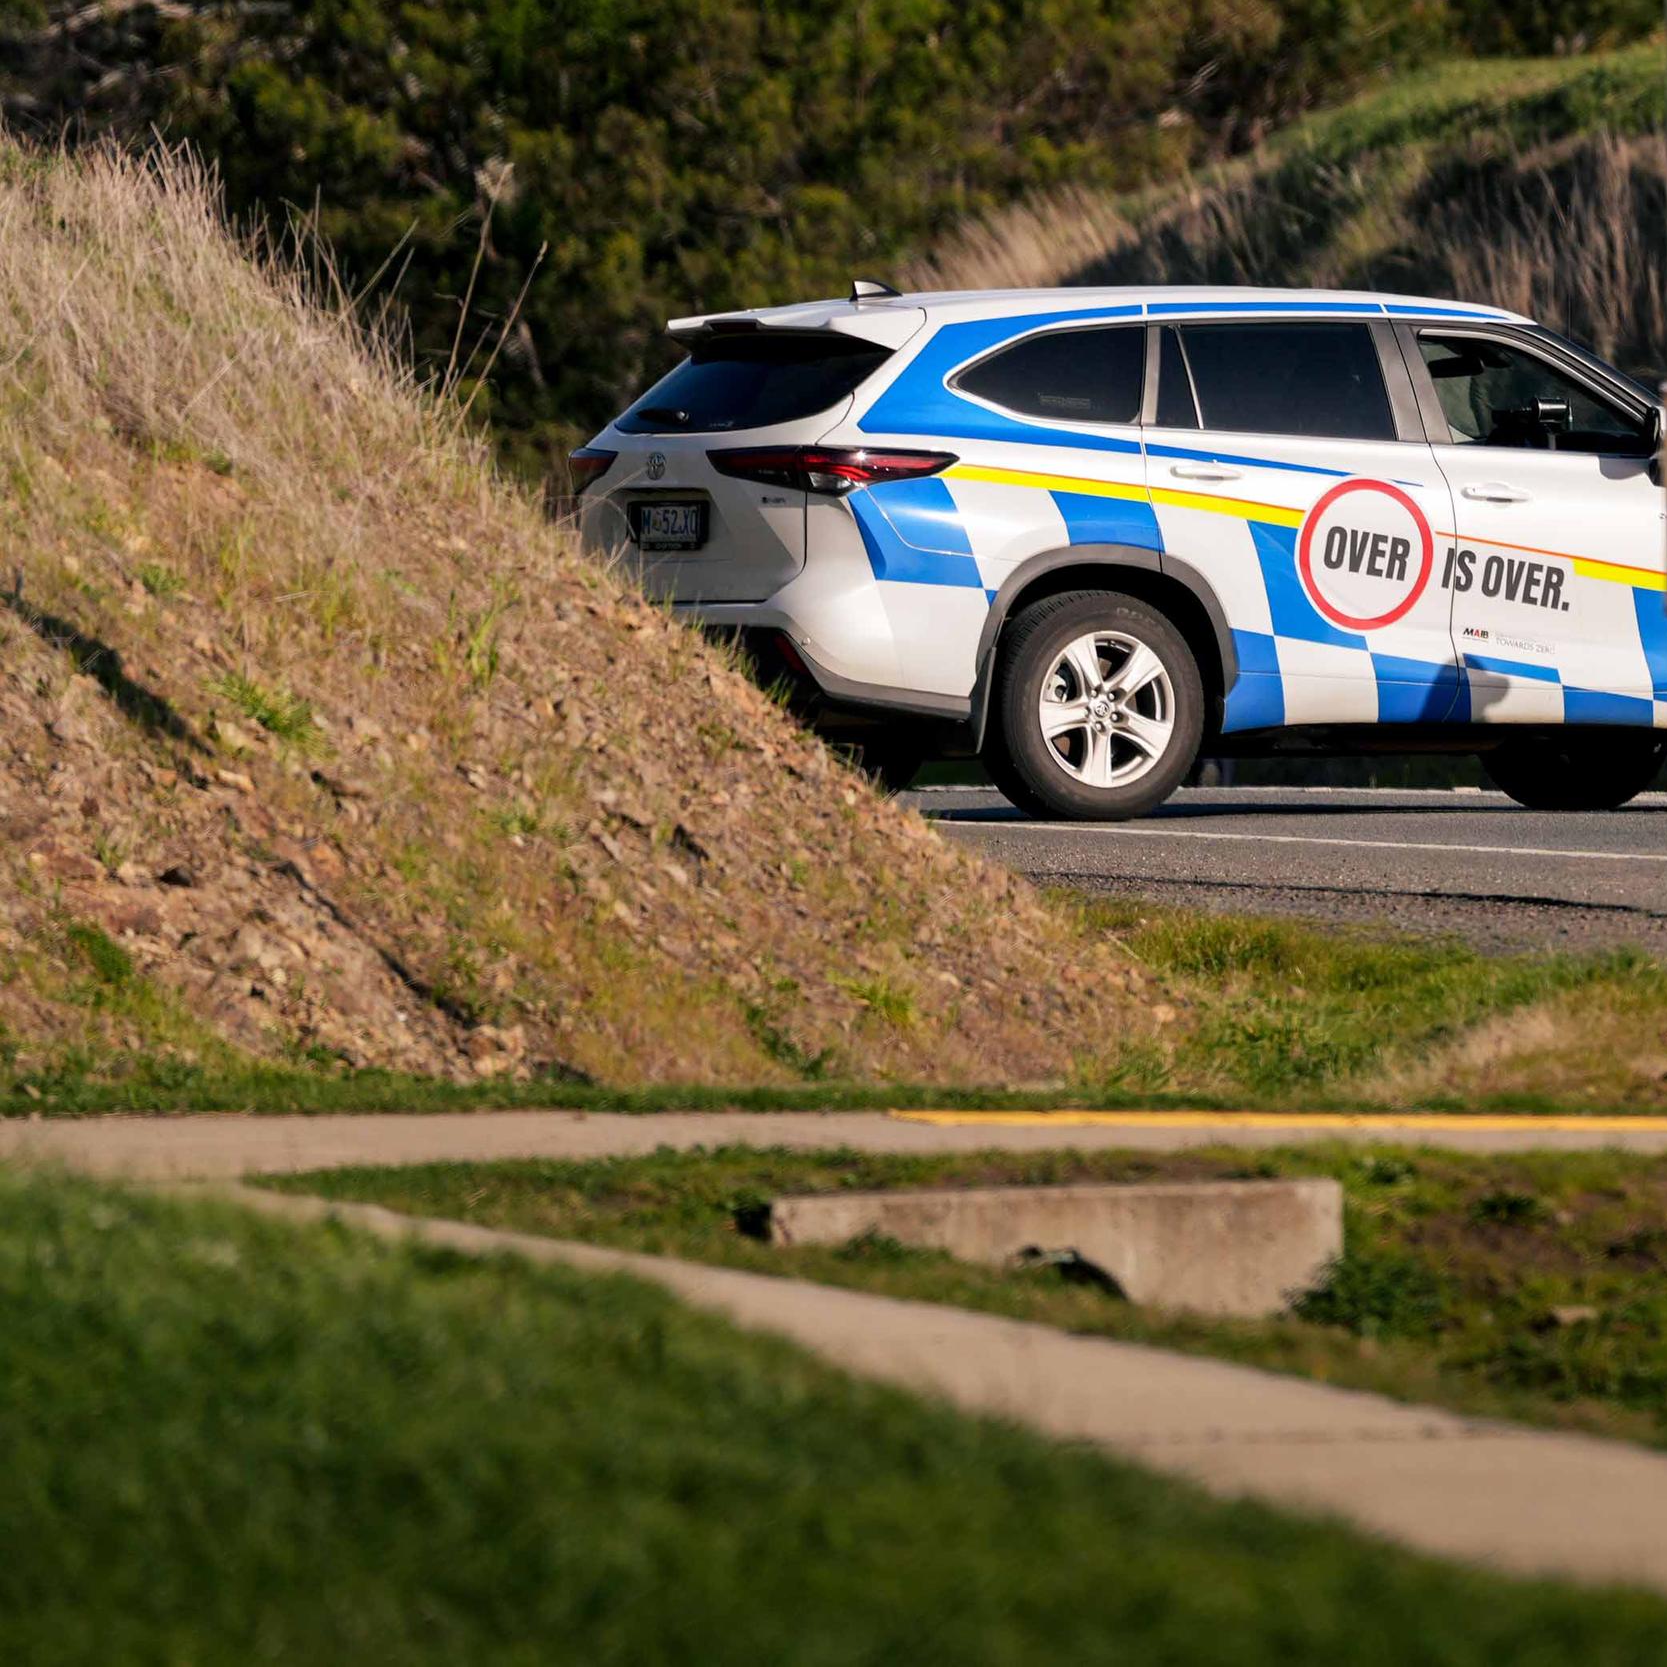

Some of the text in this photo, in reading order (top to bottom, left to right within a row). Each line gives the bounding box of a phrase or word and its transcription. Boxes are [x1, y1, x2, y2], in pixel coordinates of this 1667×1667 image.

[1324, 526, 1570, 611] OVER IS OVER.
[1463, 628, 1489, 639] MAIB
[1496, 637, 1534, 651] TOWARDS
